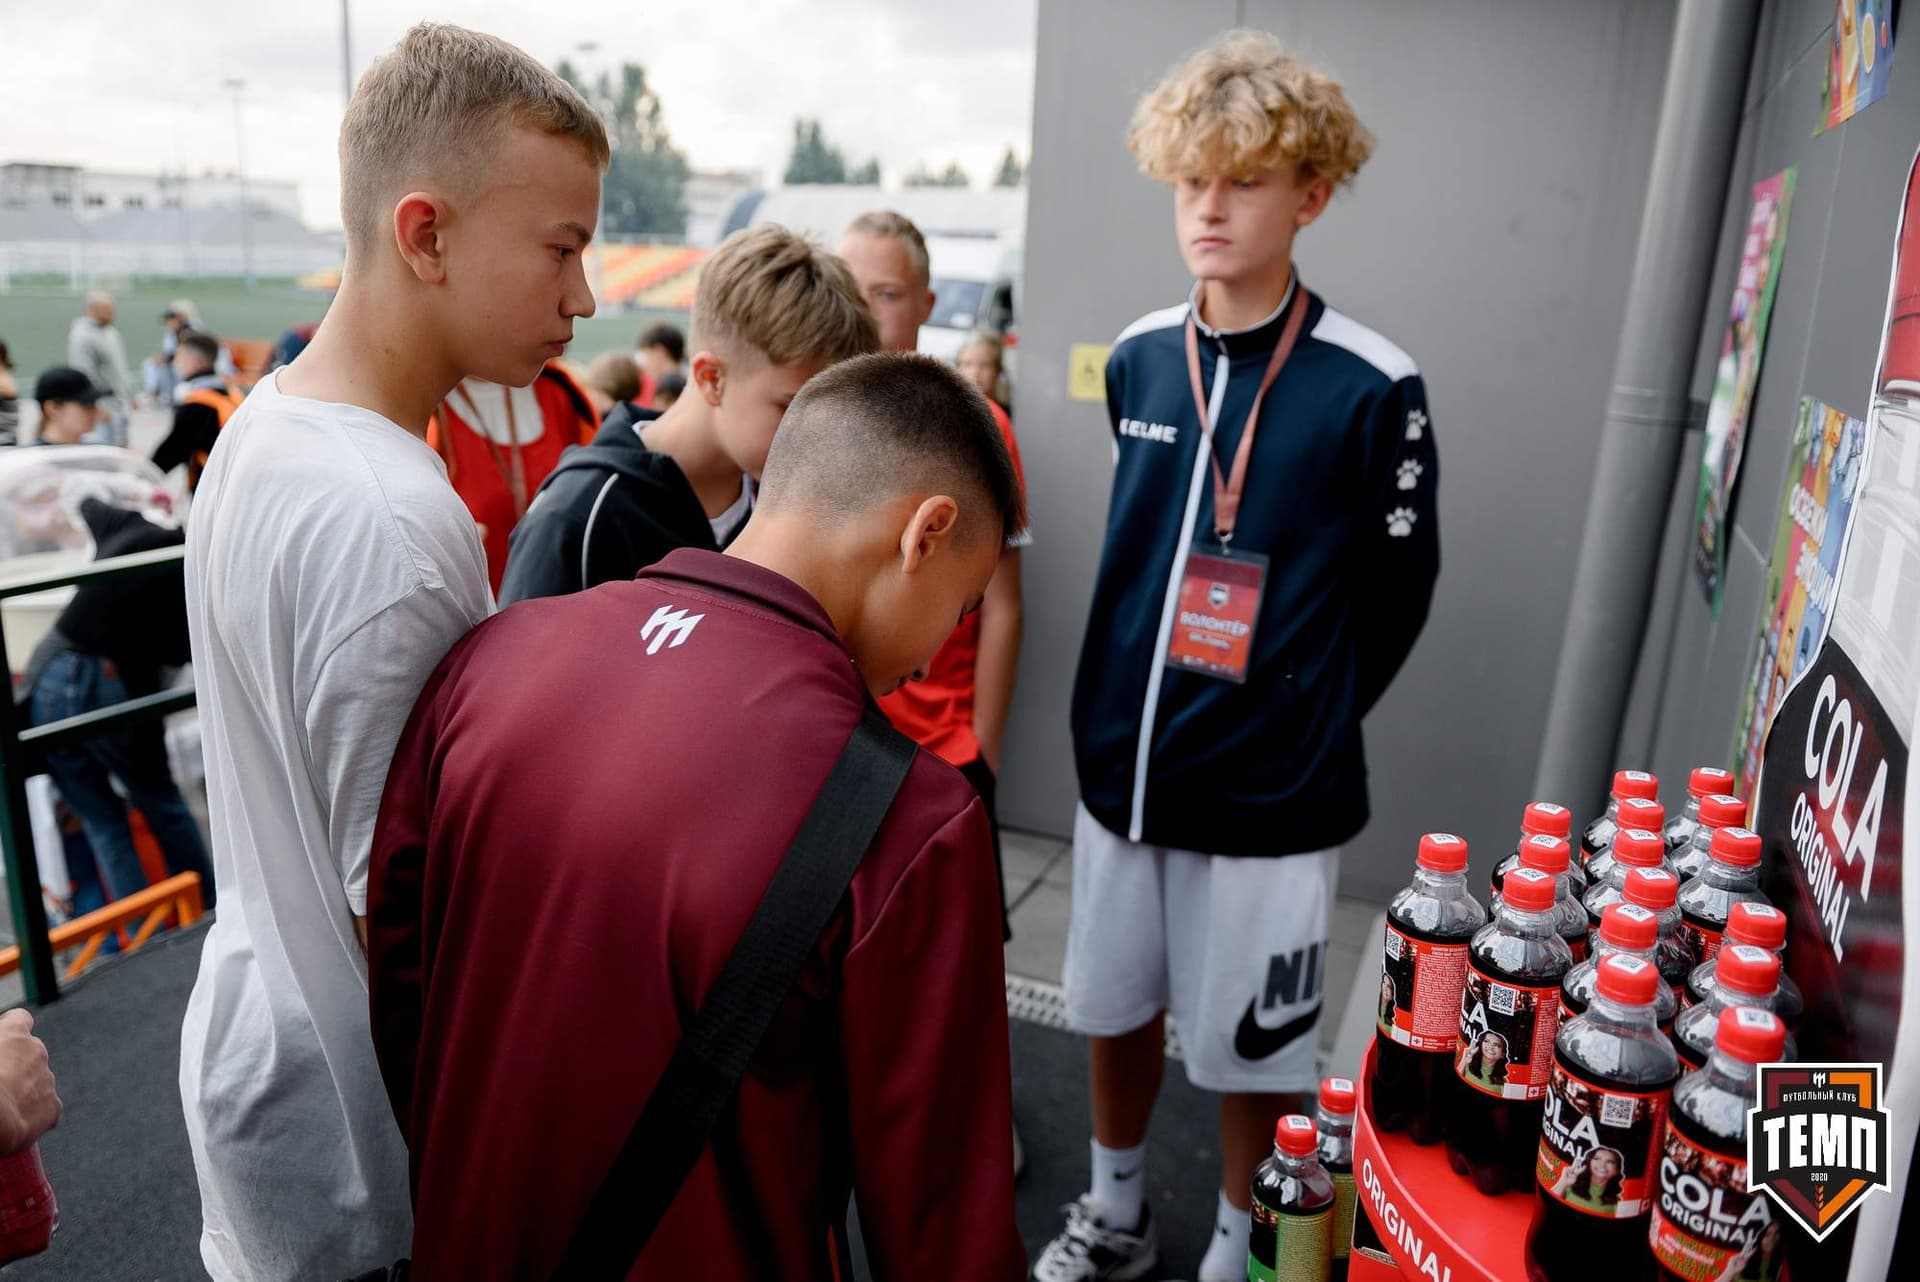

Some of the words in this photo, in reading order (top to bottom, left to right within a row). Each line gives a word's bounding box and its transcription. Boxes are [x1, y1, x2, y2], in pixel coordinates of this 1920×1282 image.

[1805, 674, 1888, 903] COLA
[1791, 792, 1850, 964] ORIGINAL
[1262, 941, 1328, 1010] NI
[1661, 1156, 1772, 1228] COLA
